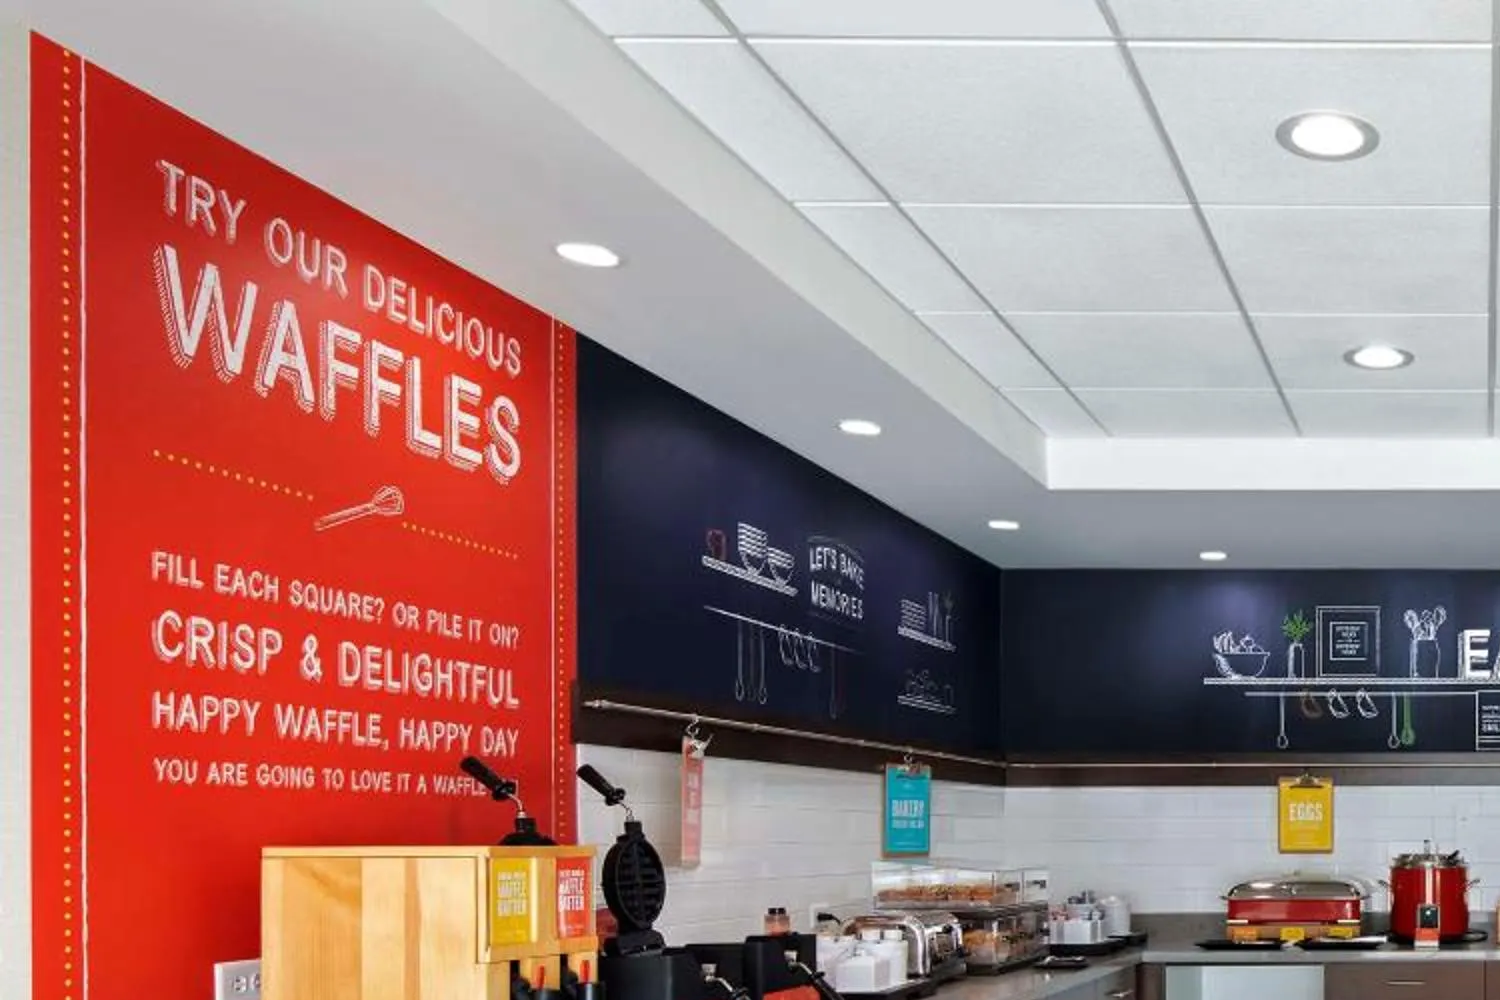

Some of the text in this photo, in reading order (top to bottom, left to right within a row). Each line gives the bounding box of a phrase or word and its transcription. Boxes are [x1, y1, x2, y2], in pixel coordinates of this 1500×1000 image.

[156, 158, 522, 378] TRY OUR DELICIOUS
[153, 243, 523, 486] WAFFLES
[809, 546, 837, 572] LET'S
[152, 550, 520, 652] FILL EACH SQUARE? OR PILE IT ON?
[811, 580, 864, 621] MEMORIES
[152, 608, 521, 711] CRISP & DELIGHTFUL
[152, 689, 519, 758] HAPPY WAFFLE, HAPPY DAY
[153, 756, 199, 789] YOU
[204, 760, 249, 788] ARE
[255, 762, 316, 791] GOING
[321, 766, 345, 792] TO
[350, 768, 393, 795] LOVE
[397, 772, 412, 795] IT
[416, 773, 427, 796] A
[1288, 802, 1324, 823] EGGS
